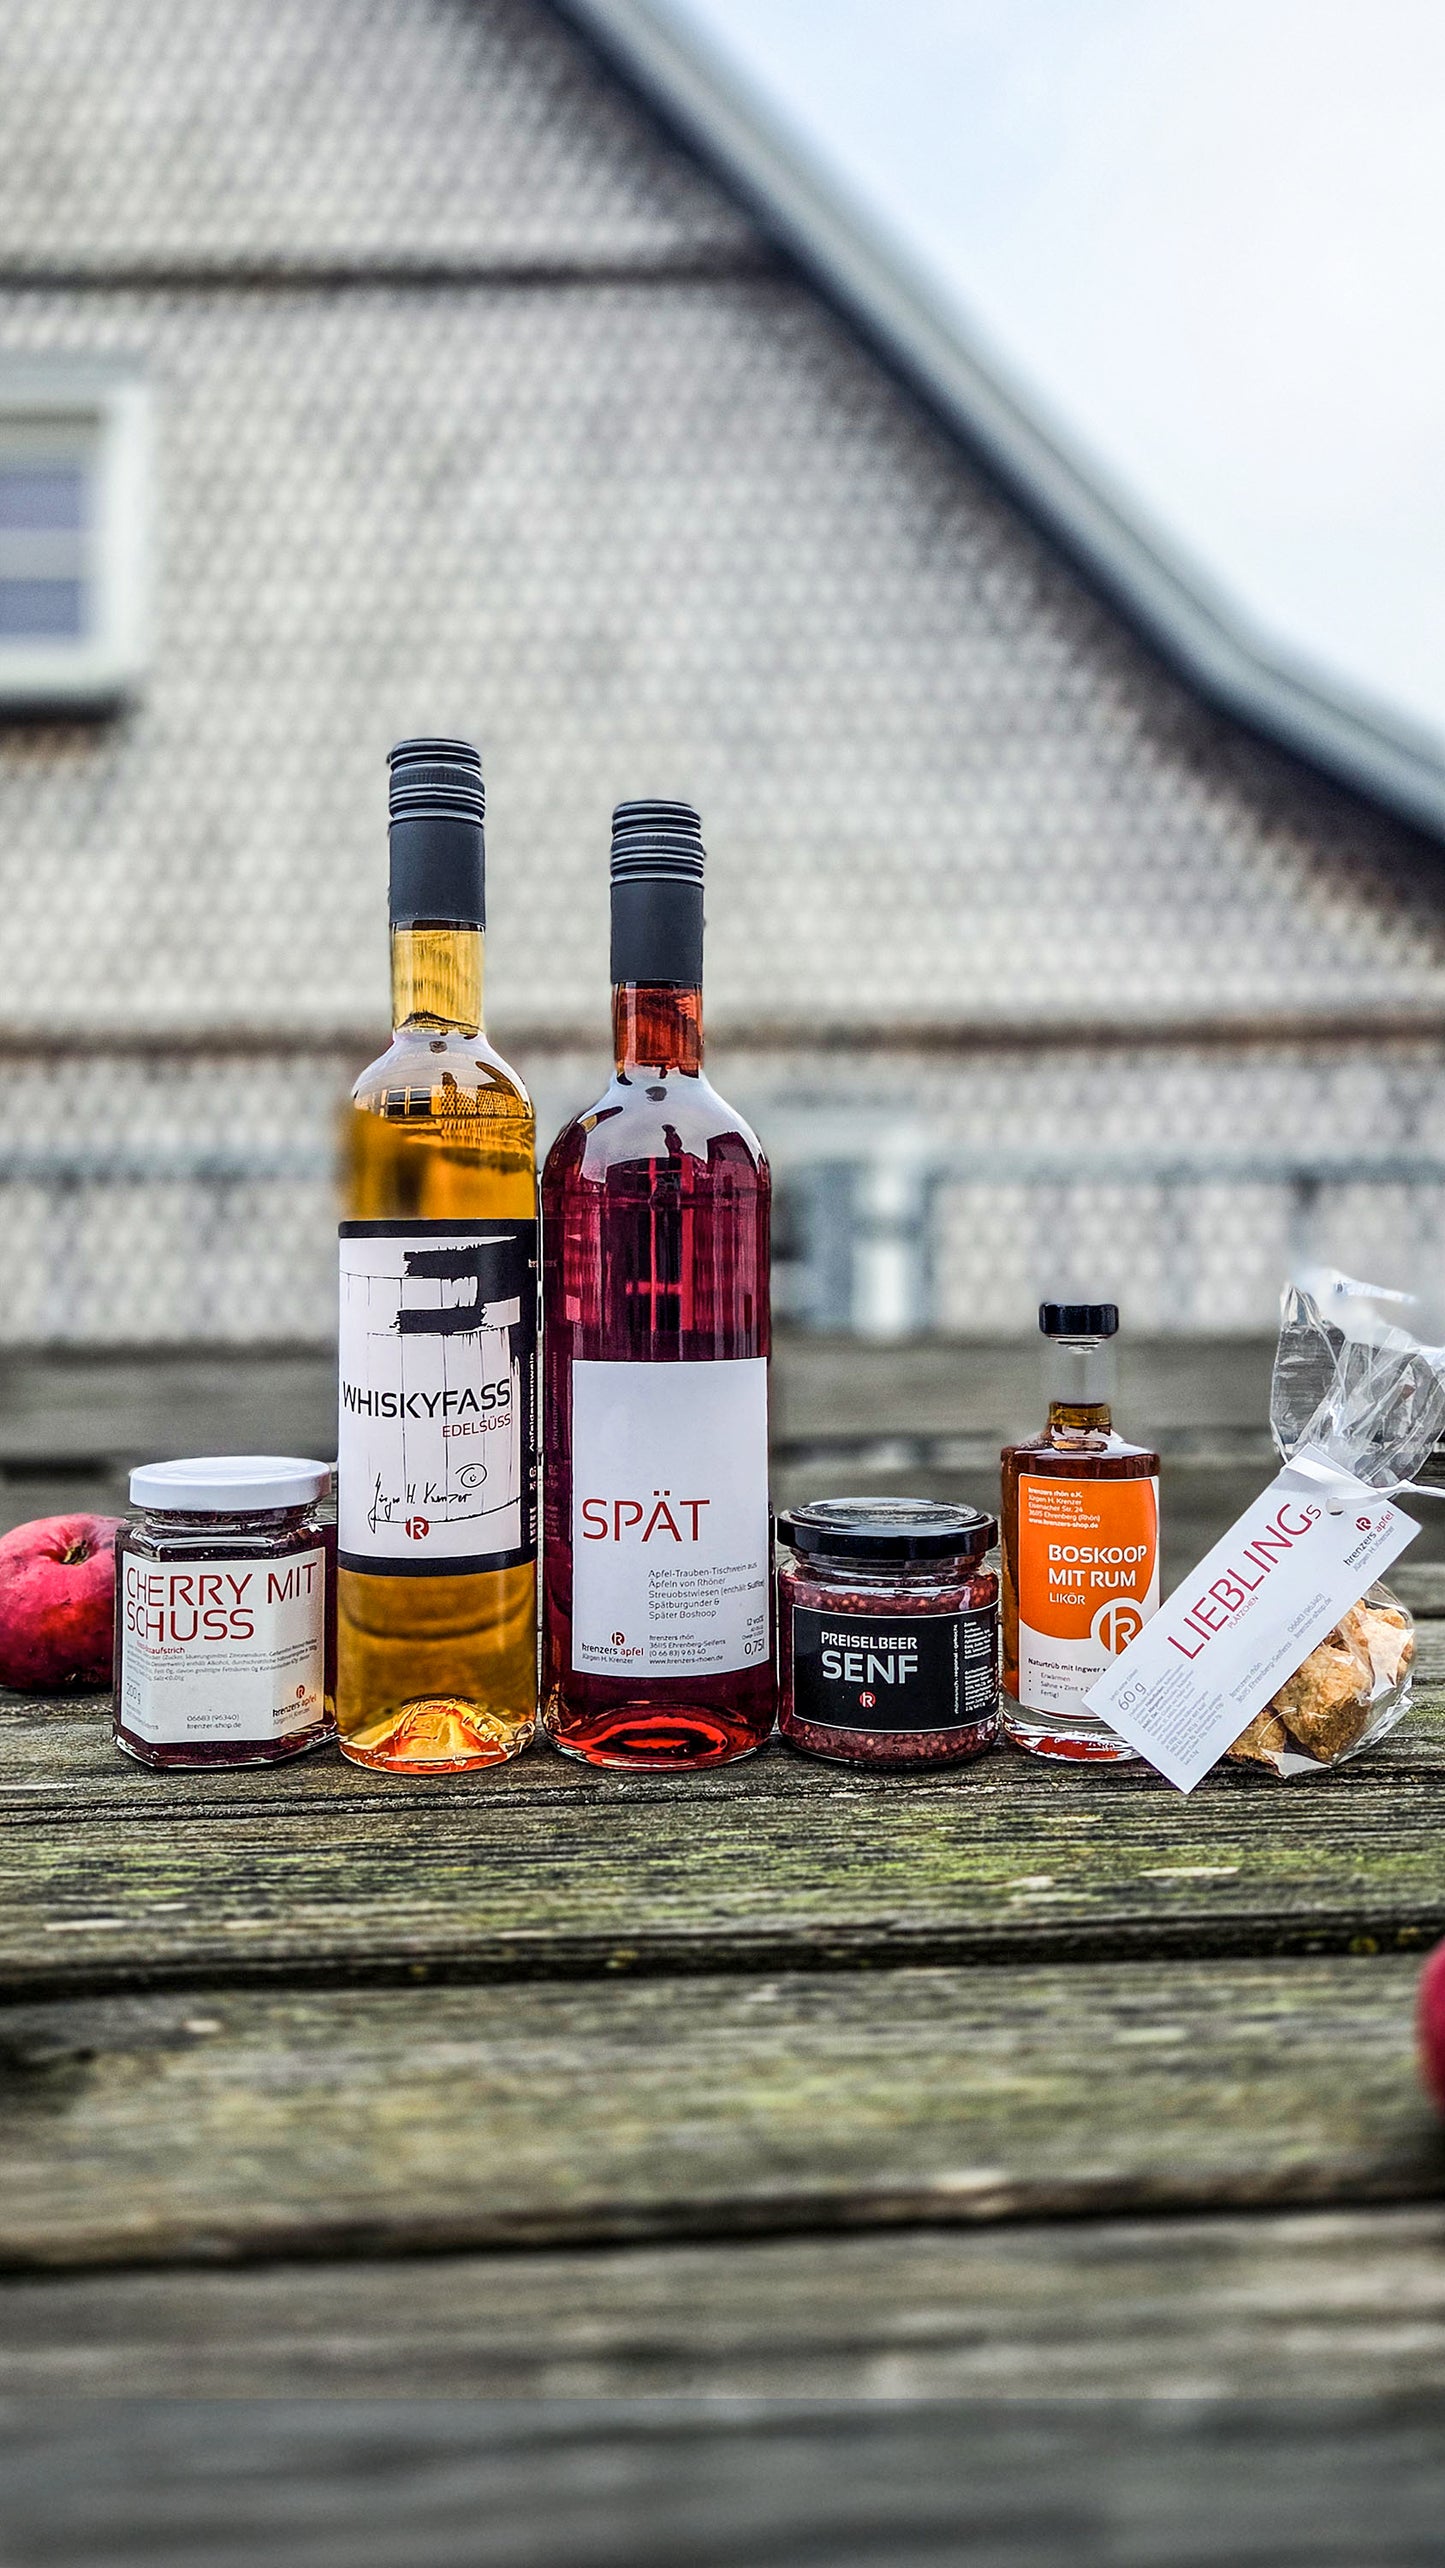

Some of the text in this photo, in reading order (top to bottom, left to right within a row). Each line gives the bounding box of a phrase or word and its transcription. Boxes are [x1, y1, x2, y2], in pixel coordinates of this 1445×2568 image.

[342, 1378, 511, 1418] WHISKYFASS
[442, 1413, 511, 1438] EDELSÜSS
[582, 1490, 711, 1542] SPÄT
[1375, 1510, 1395, 1533] apfel
[1048, 1544, 1147, 1564] BOSKOOP
[648, 1563, 746, 1579] Apfel-Trauben-Tischwein
[1048, 1567, 1136, 1588] MIT RUM
[126, 1561, 317, 1607] CHERRY MIT
[697, 1578, 725, 1586] Rhöner
[648, 1588, 719, 1599] Streuobstwiesen
[1049, 1591, 1086, 1605] LIKÖR
[648, 1599, 712, 1610] Spätburgunder
[127, 1602, 254, 1642] SCHUSS
[648, 1611, 677, 1620] Später
[821, 1631, 918, 1650] PREISELBEER
[608, 1656, 633, 1664] Krenzer
[620, 1647, 644, 1657] apfel
[821, 1650, 918, 1684] SENF
[1028, 1657, 1060, 1670] Naturtrüb
[1075, 1665, 1100, 1673] Ingwer
[301, 1694, 317, 1706] apfel
[1118, 1690, 1136, 1711] 60
[1135, 1682, 1146, 1695] g
